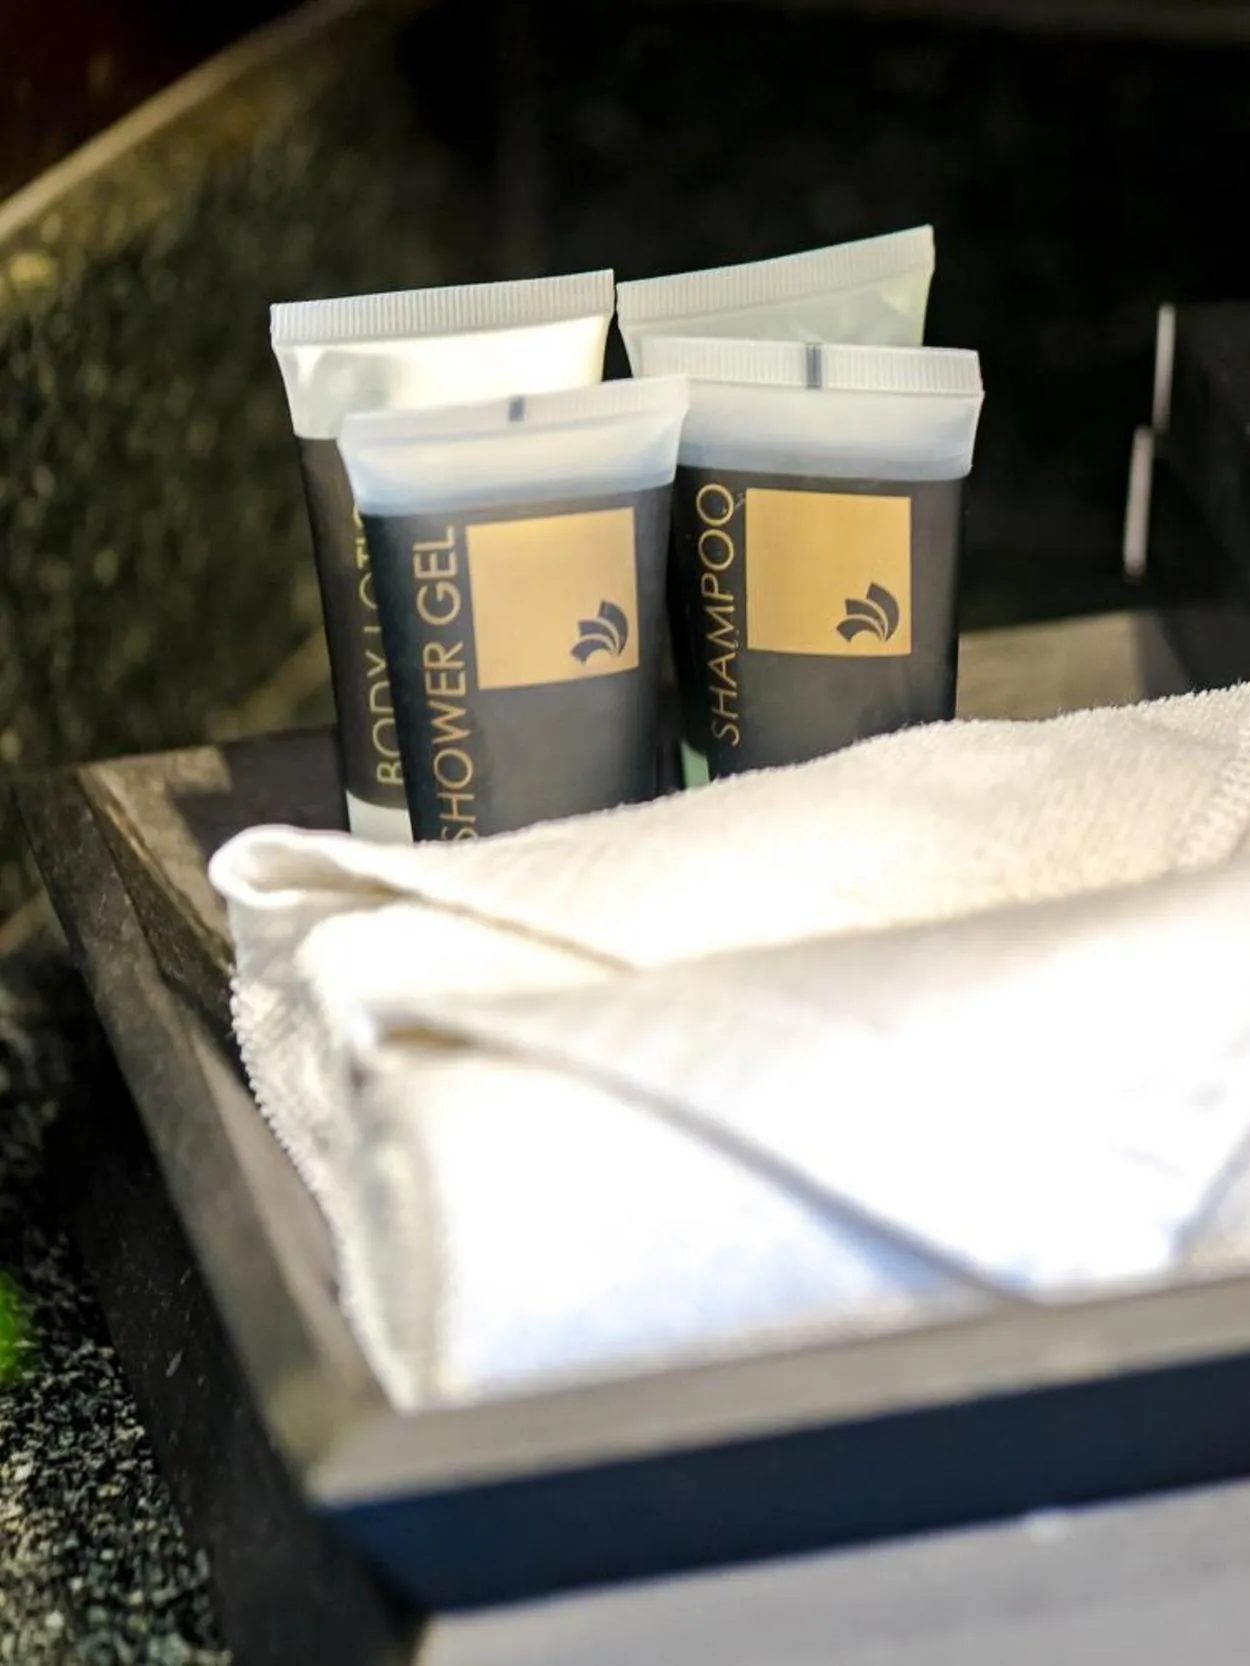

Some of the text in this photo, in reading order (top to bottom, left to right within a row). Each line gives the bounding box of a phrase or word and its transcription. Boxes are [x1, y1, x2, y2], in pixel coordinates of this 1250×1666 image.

[412, 524, 479, 841] SHOWER GEL
[695, 482, 741, 748] SHAMPOO
